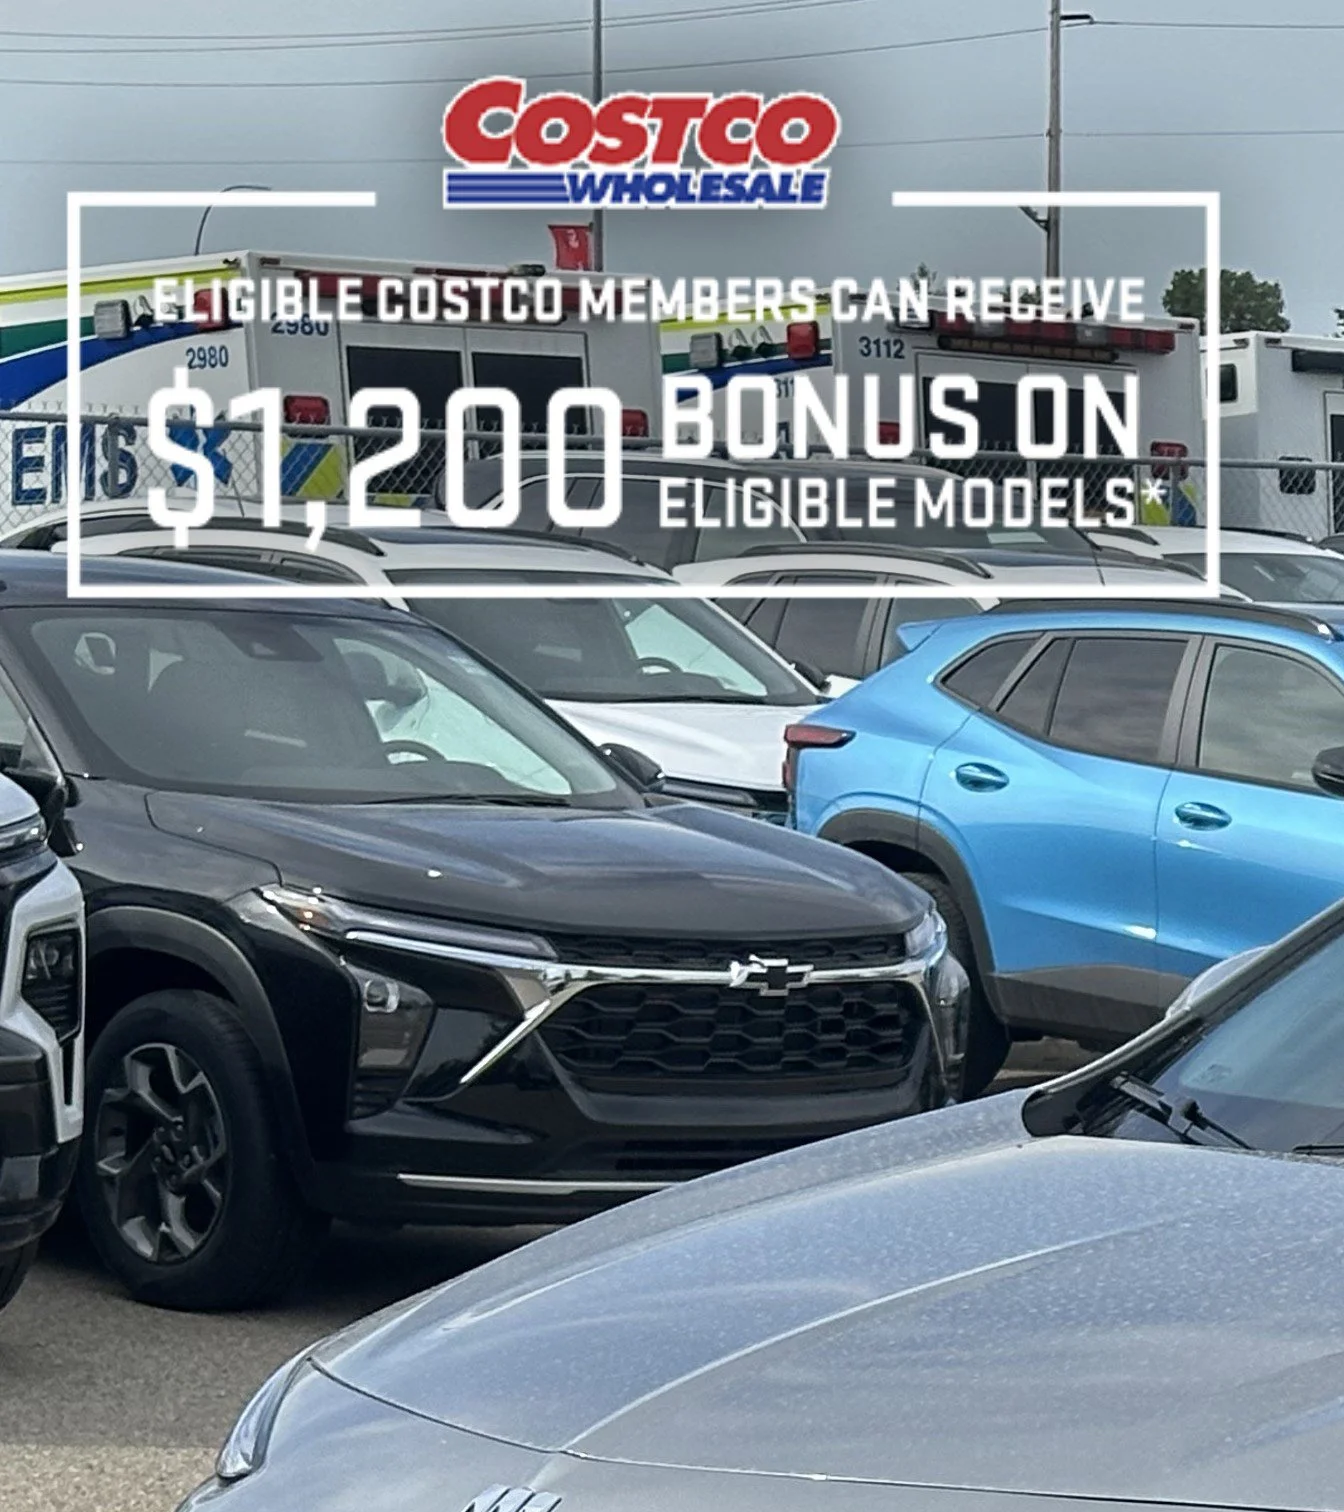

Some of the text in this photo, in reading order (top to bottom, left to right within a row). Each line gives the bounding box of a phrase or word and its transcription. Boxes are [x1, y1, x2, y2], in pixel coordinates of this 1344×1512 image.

[185, 344, 230, 370] 2980
[858, 335, 905, 360] 3112
[12, 420, 139, 506] EMS
